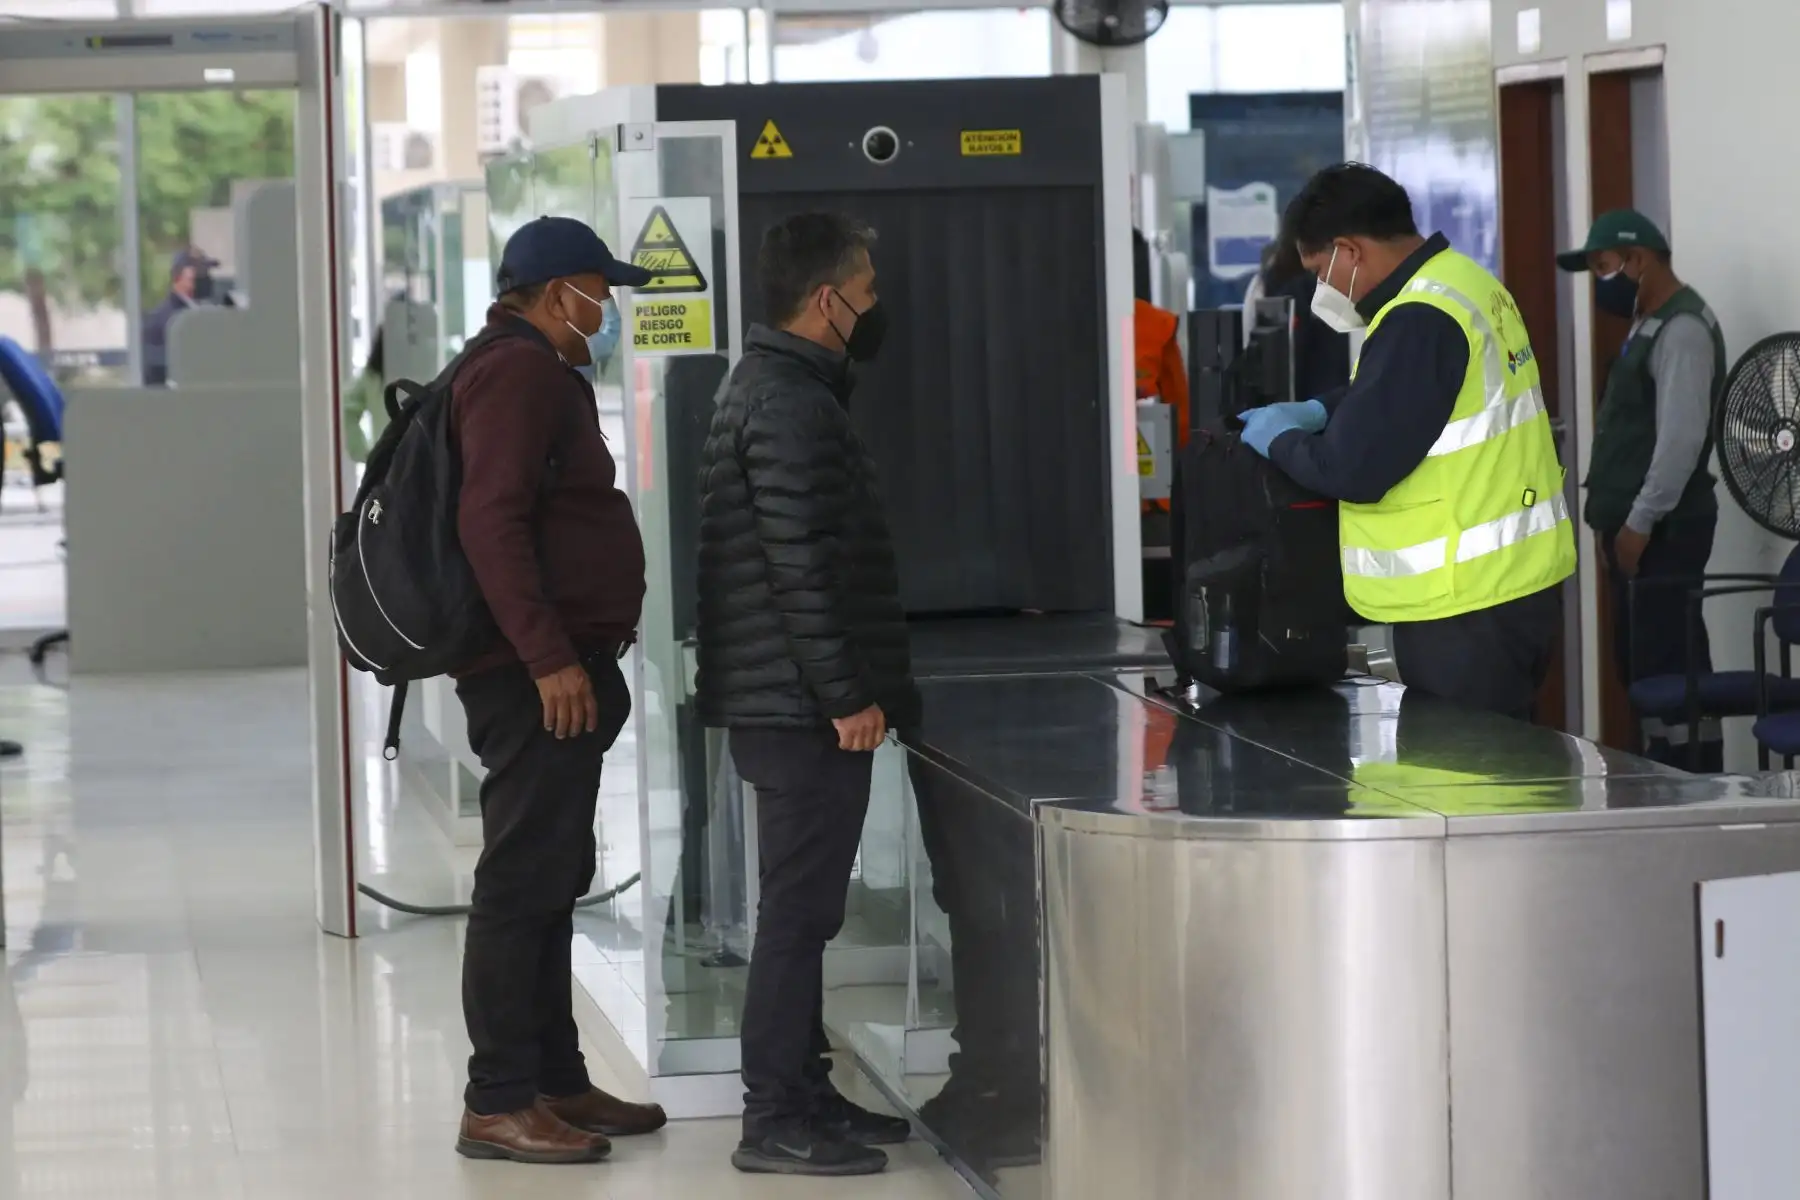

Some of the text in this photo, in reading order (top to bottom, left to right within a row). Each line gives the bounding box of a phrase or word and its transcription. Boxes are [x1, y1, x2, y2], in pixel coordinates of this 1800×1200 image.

[968, 142, 1014, 152] RAYOS X
[635, 304, 687, 316] PELIGRO
[639, 319, 684, 330] RIESGO
[633, 332, 692, 344] DE CORTE
